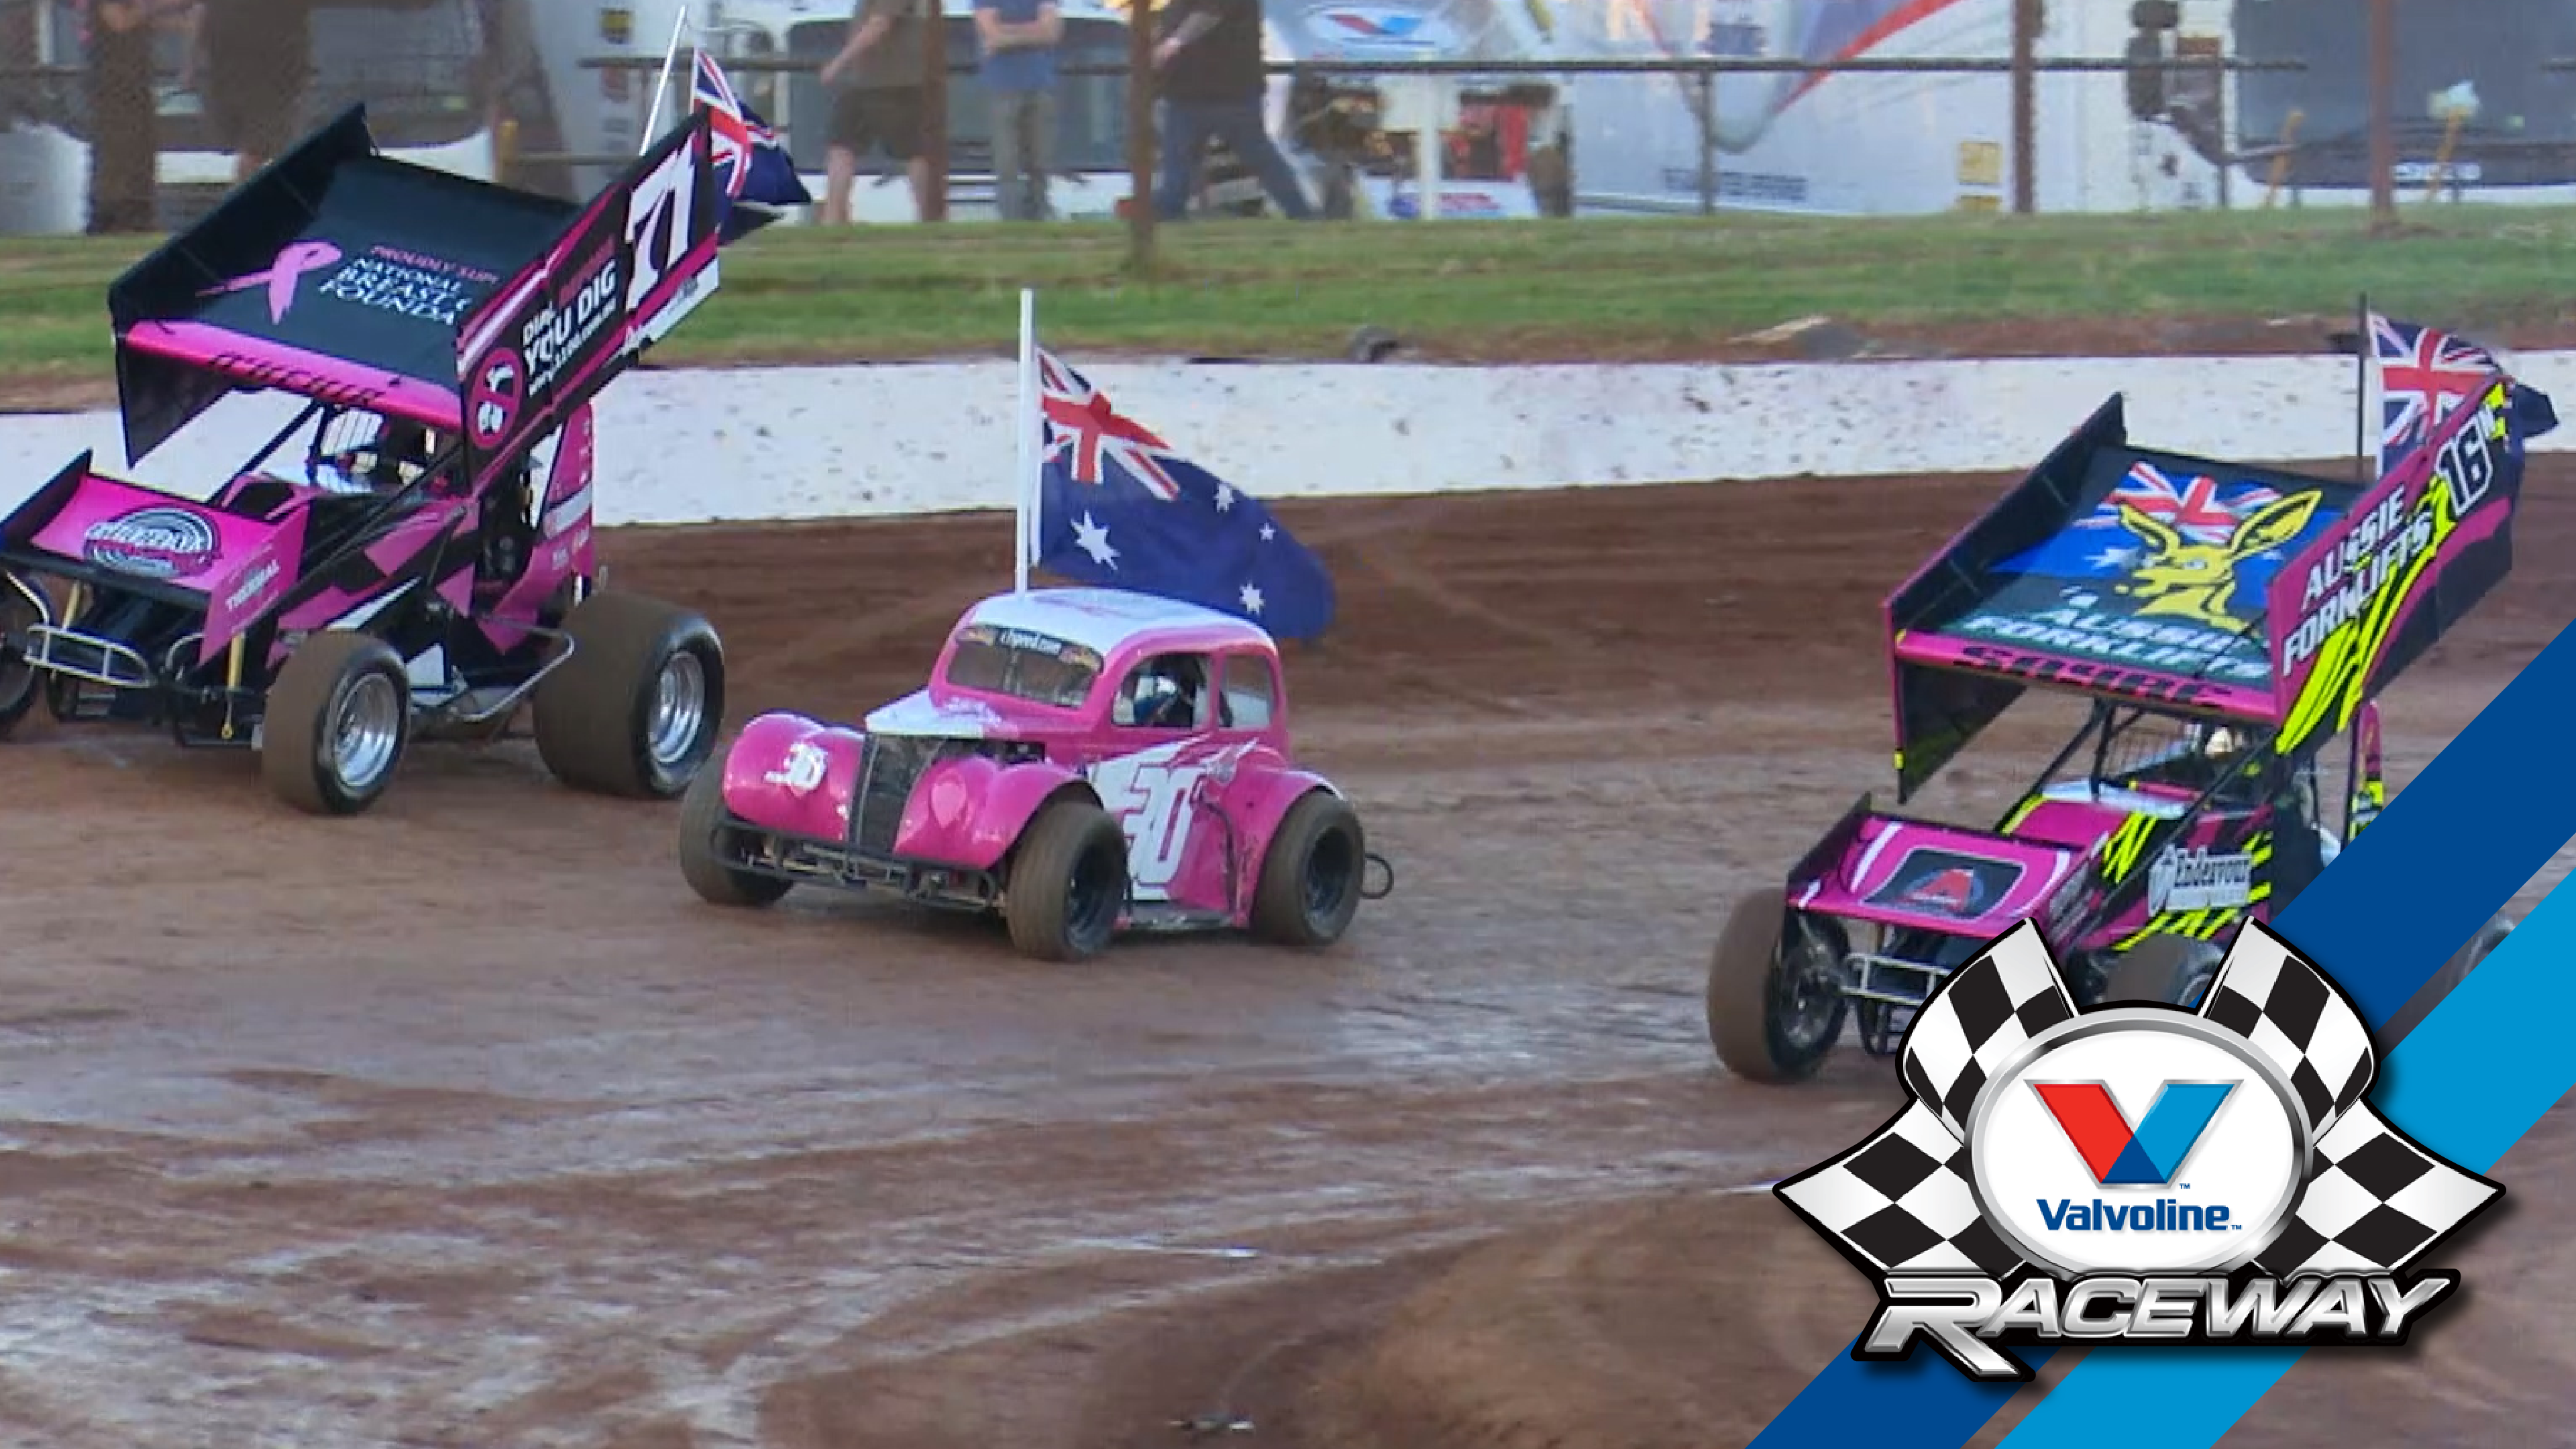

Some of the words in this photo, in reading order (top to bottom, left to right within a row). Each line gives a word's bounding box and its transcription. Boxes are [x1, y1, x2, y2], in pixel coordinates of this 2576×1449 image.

[353, 256, 464, 294] NATIONAL
[625, 130, 696, 312] 71
[335, 266, 451, 305] BREAST
[524, 305, 572, 377] YOU
[577, 258, 616, 325] DIG
[2434, 413, 2493, 519] 16
[2300, 483, 2406, 613] AUSSIE
[1962, 614, 2274, 679] FORKLIFTS
[1122, 766, 1208, 884] 30
